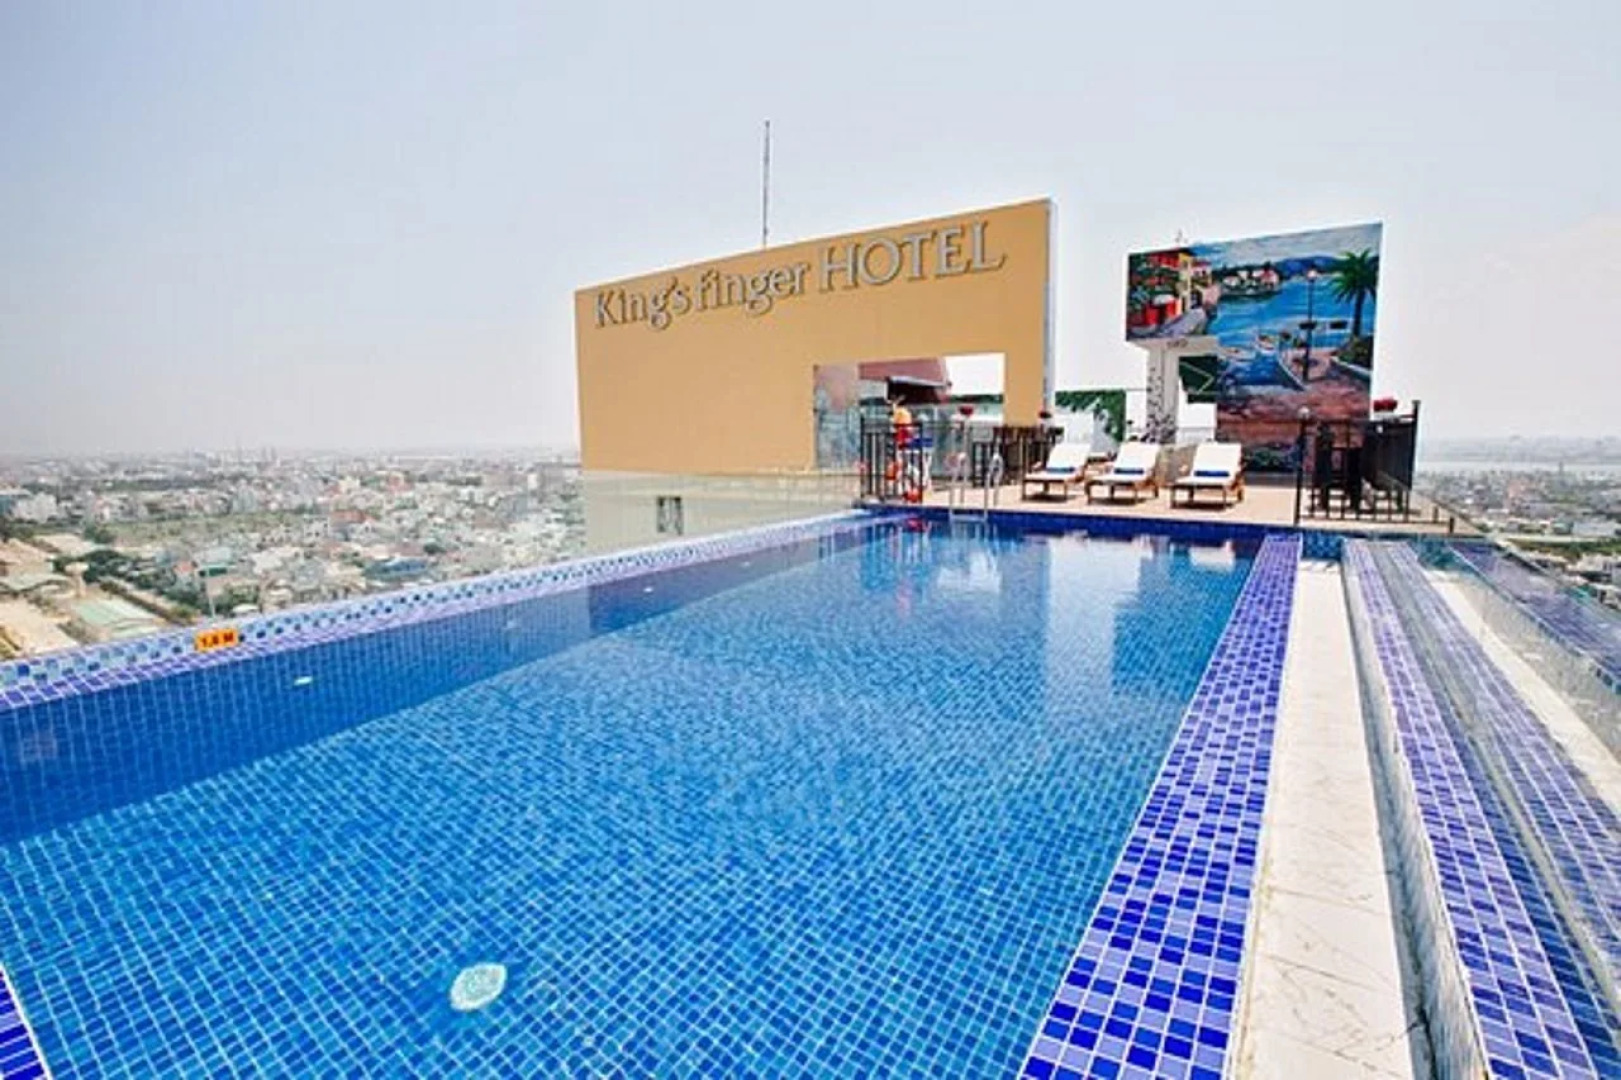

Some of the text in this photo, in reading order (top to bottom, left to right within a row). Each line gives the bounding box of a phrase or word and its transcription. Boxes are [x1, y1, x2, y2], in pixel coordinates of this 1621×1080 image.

[595, 215, 1007, 332] King's finger HOTEL
